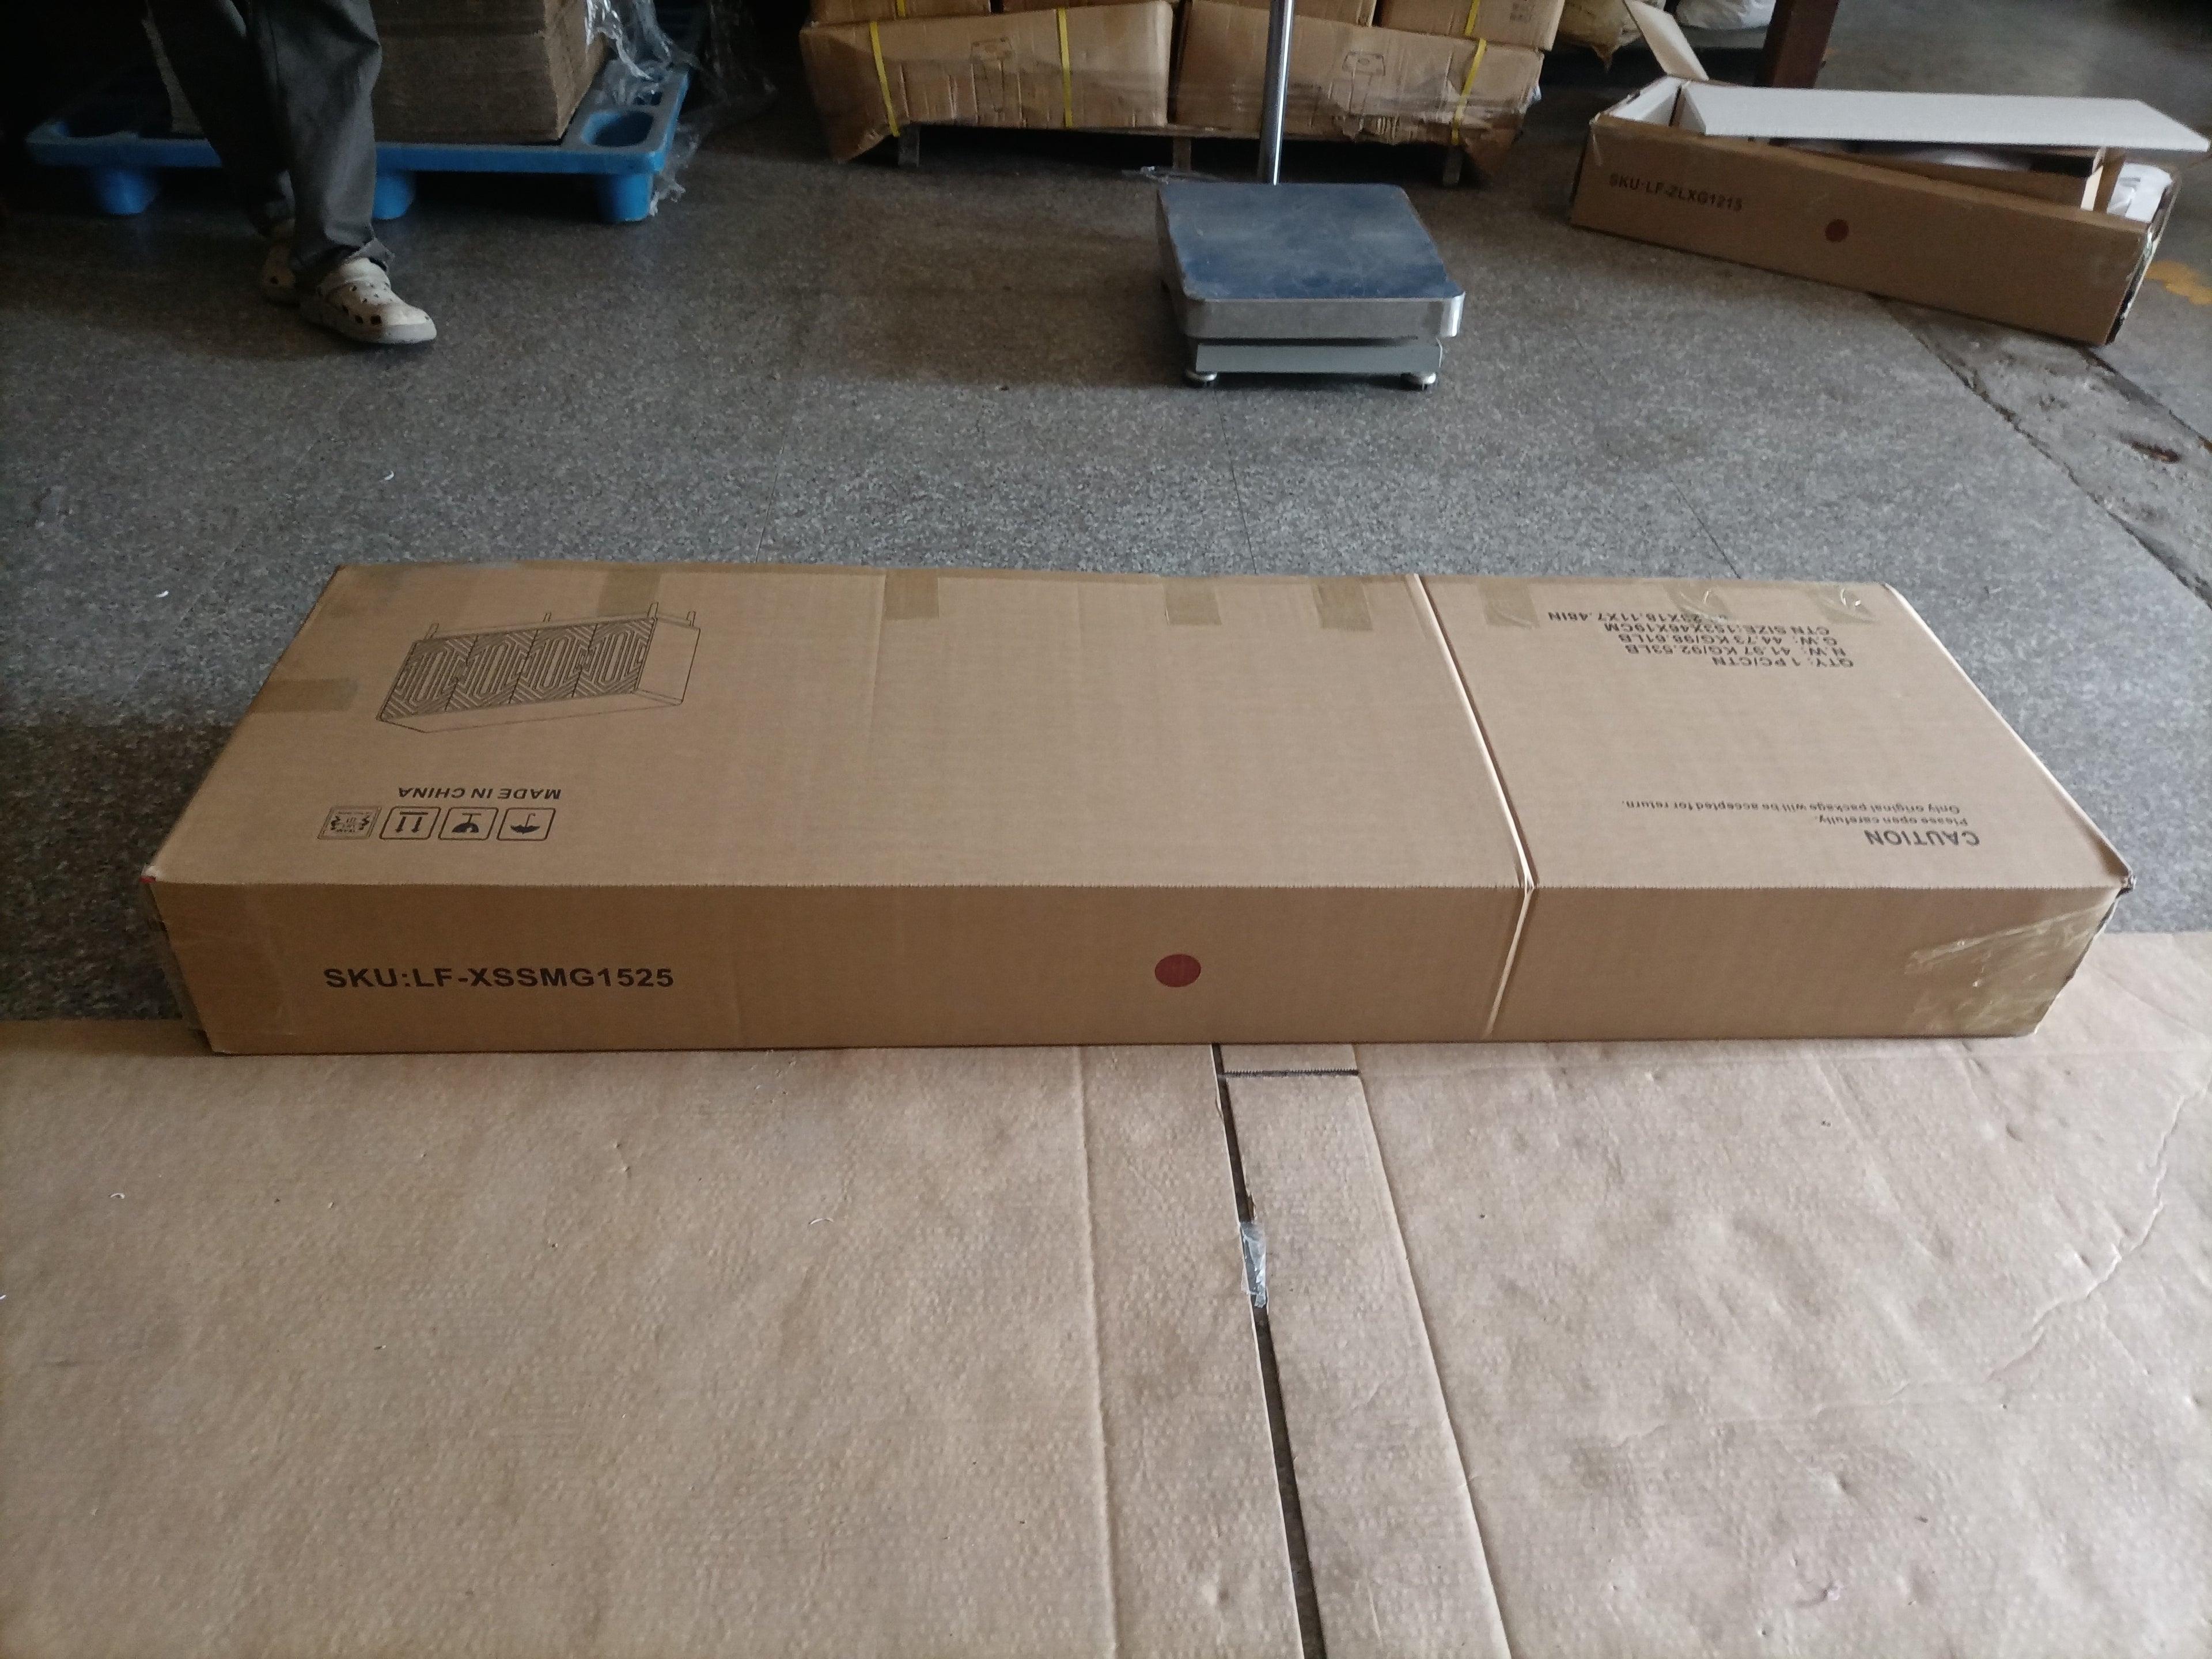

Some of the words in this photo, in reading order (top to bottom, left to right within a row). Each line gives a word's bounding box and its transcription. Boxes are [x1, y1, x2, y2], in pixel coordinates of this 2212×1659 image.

[1790, 625, 1830, 635] CTN
[1791, 657, 1801, 666] 1
[1807, 657, 1854, 668] QTY:
[398, 787, 465, 799] CHINA
[471, 787, 494, 799] IN
[497, 788, 562, 800] MADE
[1622, 800, 1669, 809] return.
[1673, 802, 1693, 810] for
[1695, 801, 1758, 811] accepted
[1762, 804, 1779, 812] be
[1782, 803, 1807, 812] will
[1809, 802, 1867, 813] package
[1871, 802, 1924, 813] original
[1927, 804, 1960, 815] Only
[1883, 815, 1918, 824] open
[1921, 817, 1968, 827] Please
[1863, 830, 1980, 847] CAUTION
[323, 967, 675, 988] SKU:LF-XSSMG1525
